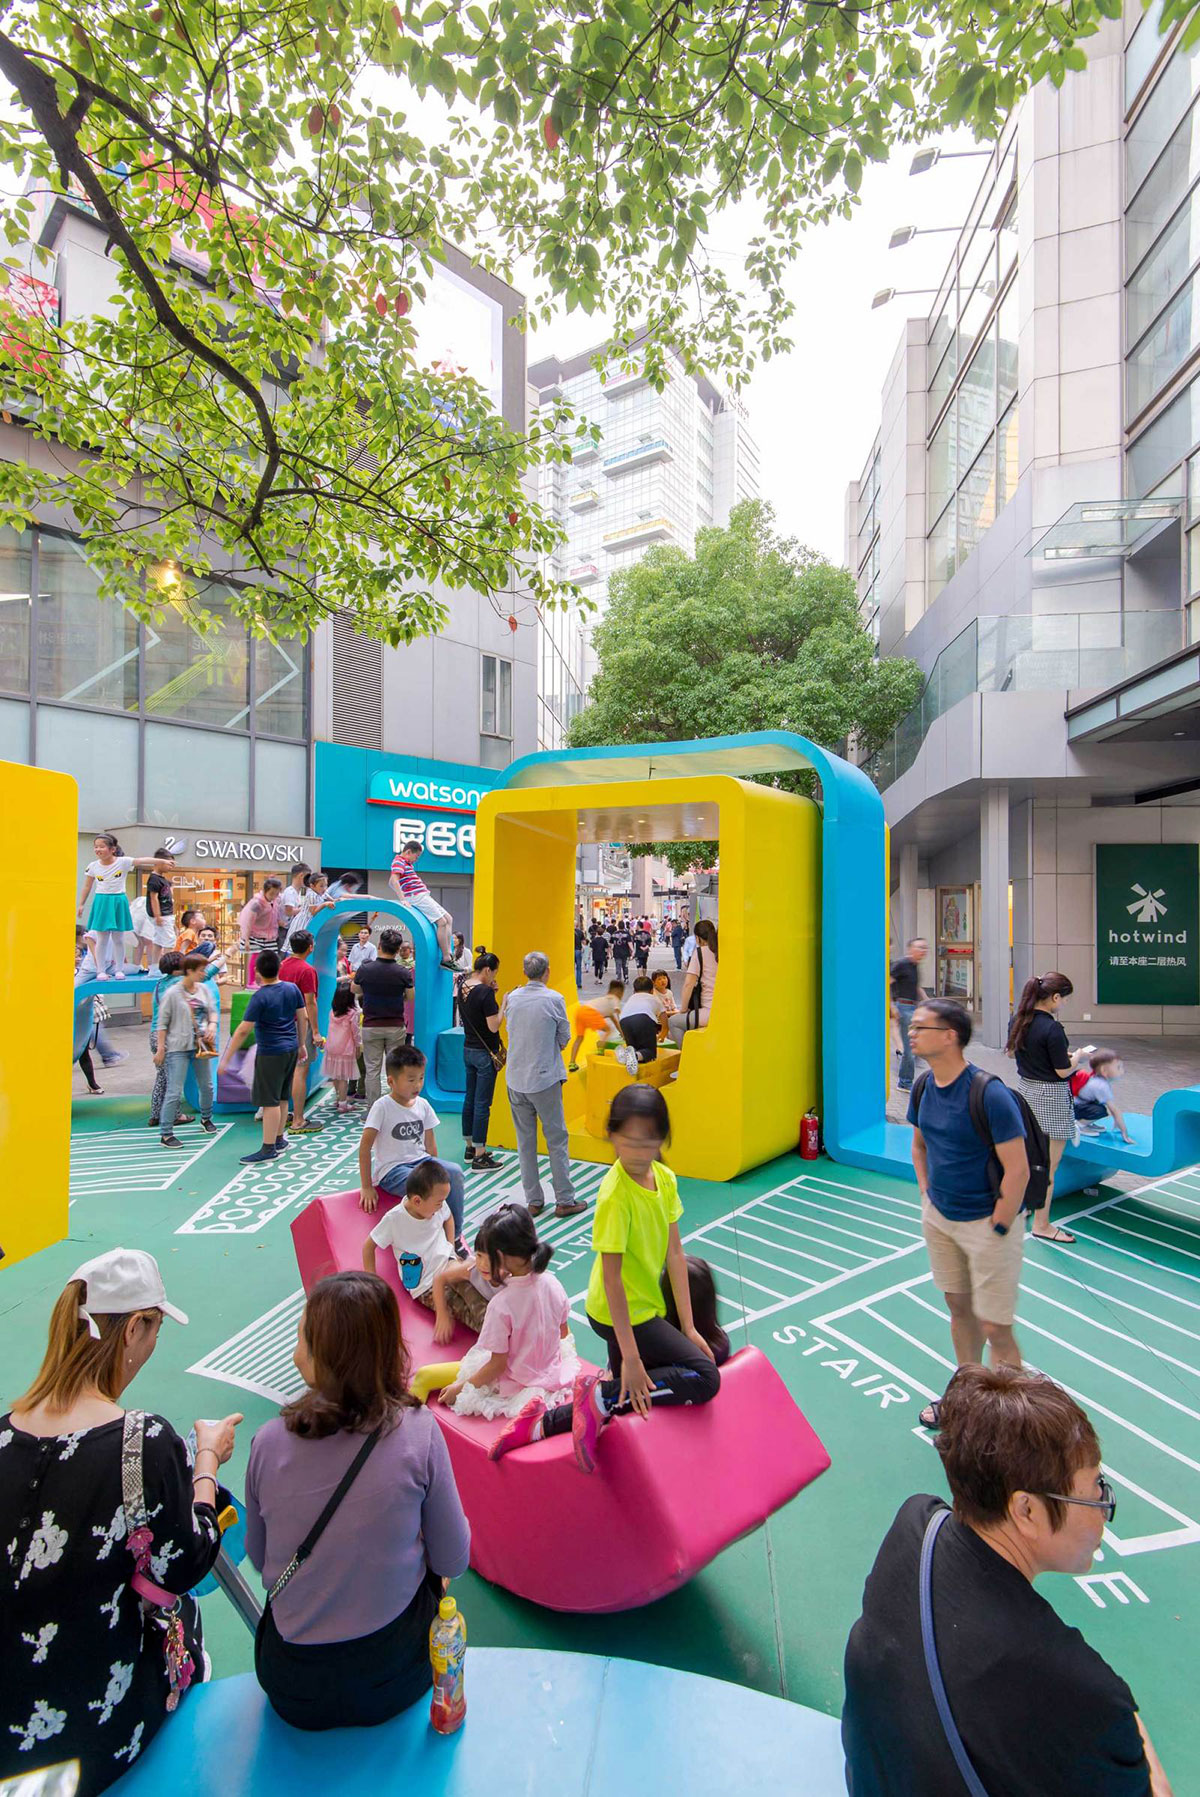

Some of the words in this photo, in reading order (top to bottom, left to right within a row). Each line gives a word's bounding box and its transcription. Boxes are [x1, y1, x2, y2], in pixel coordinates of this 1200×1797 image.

[388, 778, 487, 806] watson
[195, 839, 304, 862] SWAROVSKI
[1108, 929, 1187, 944] hotwind
[1109, 955, 1187, 967] 请至本座二层热风
[294, 1179, 351, 1209] BALL
[772, 1324, 912, 1410] STAIR
